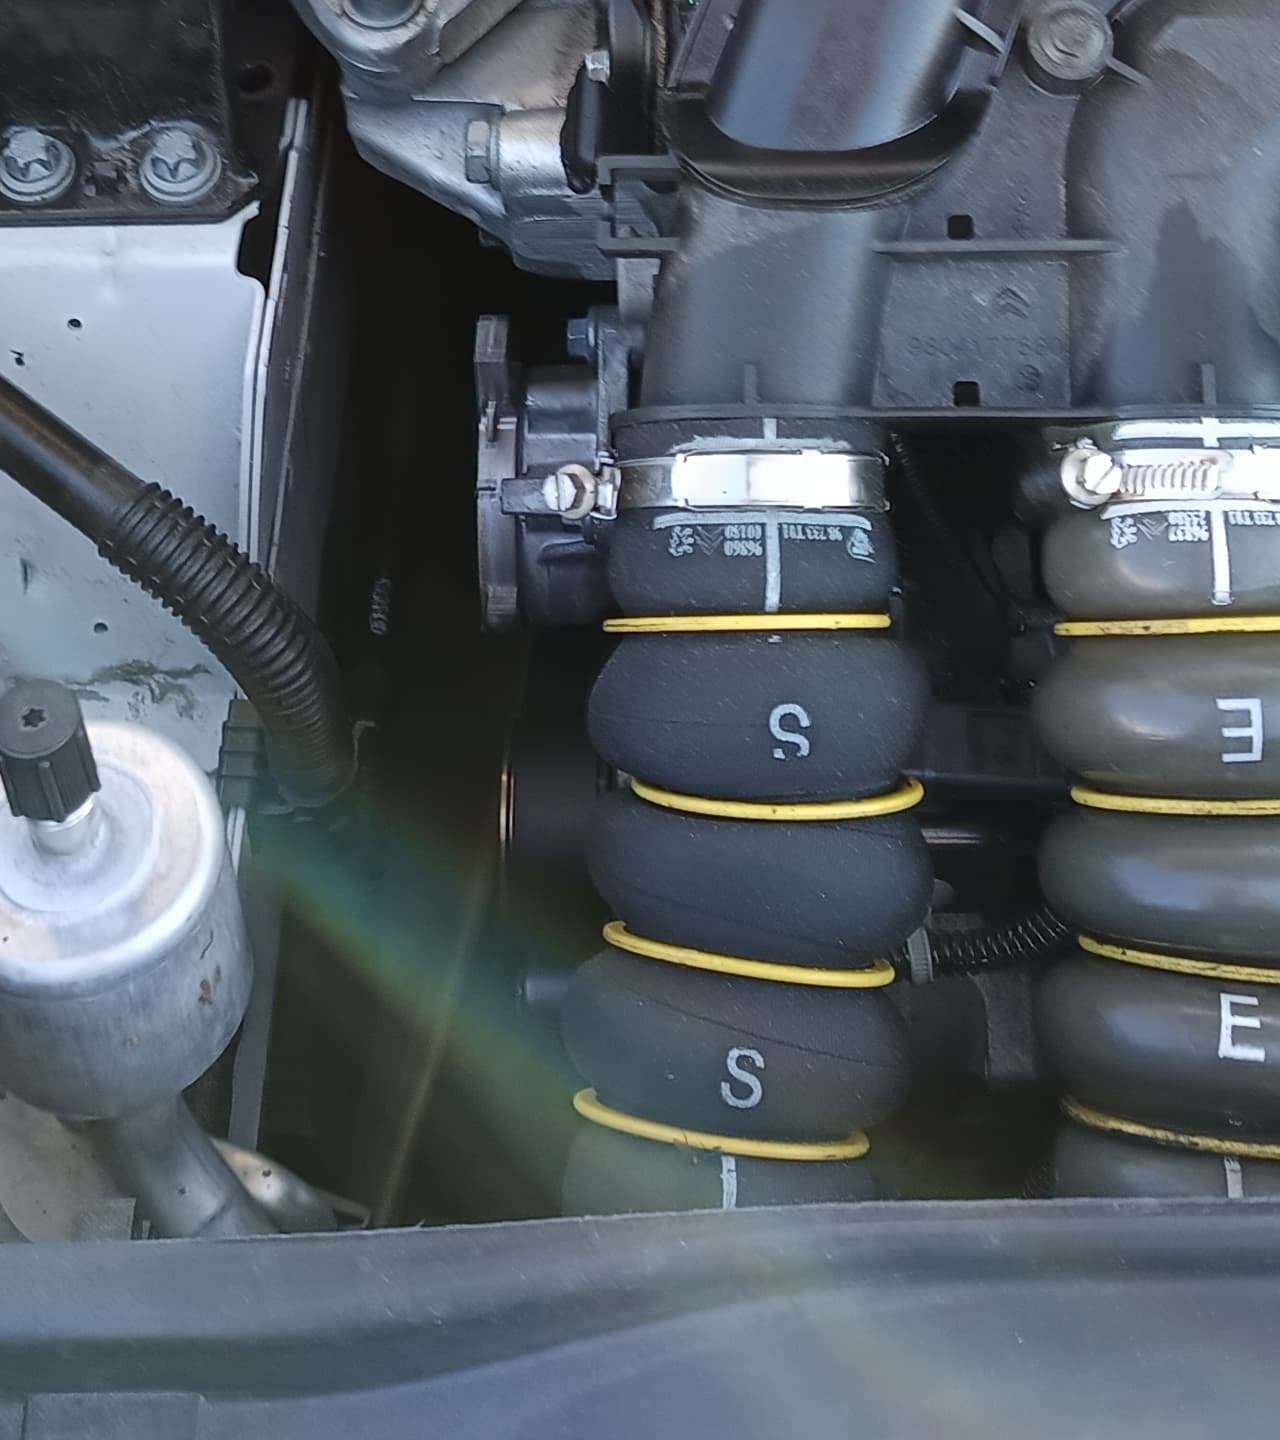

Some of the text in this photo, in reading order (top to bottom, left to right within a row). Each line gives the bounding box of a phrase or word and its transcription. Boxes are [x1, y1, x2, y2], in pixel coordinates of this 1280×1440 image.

[767, 703, 812, 760] S
[1216, 699, 1265, 763] E
[1218, 993, 1267, 1064] E
[721, 1047, 766, 1110] S
